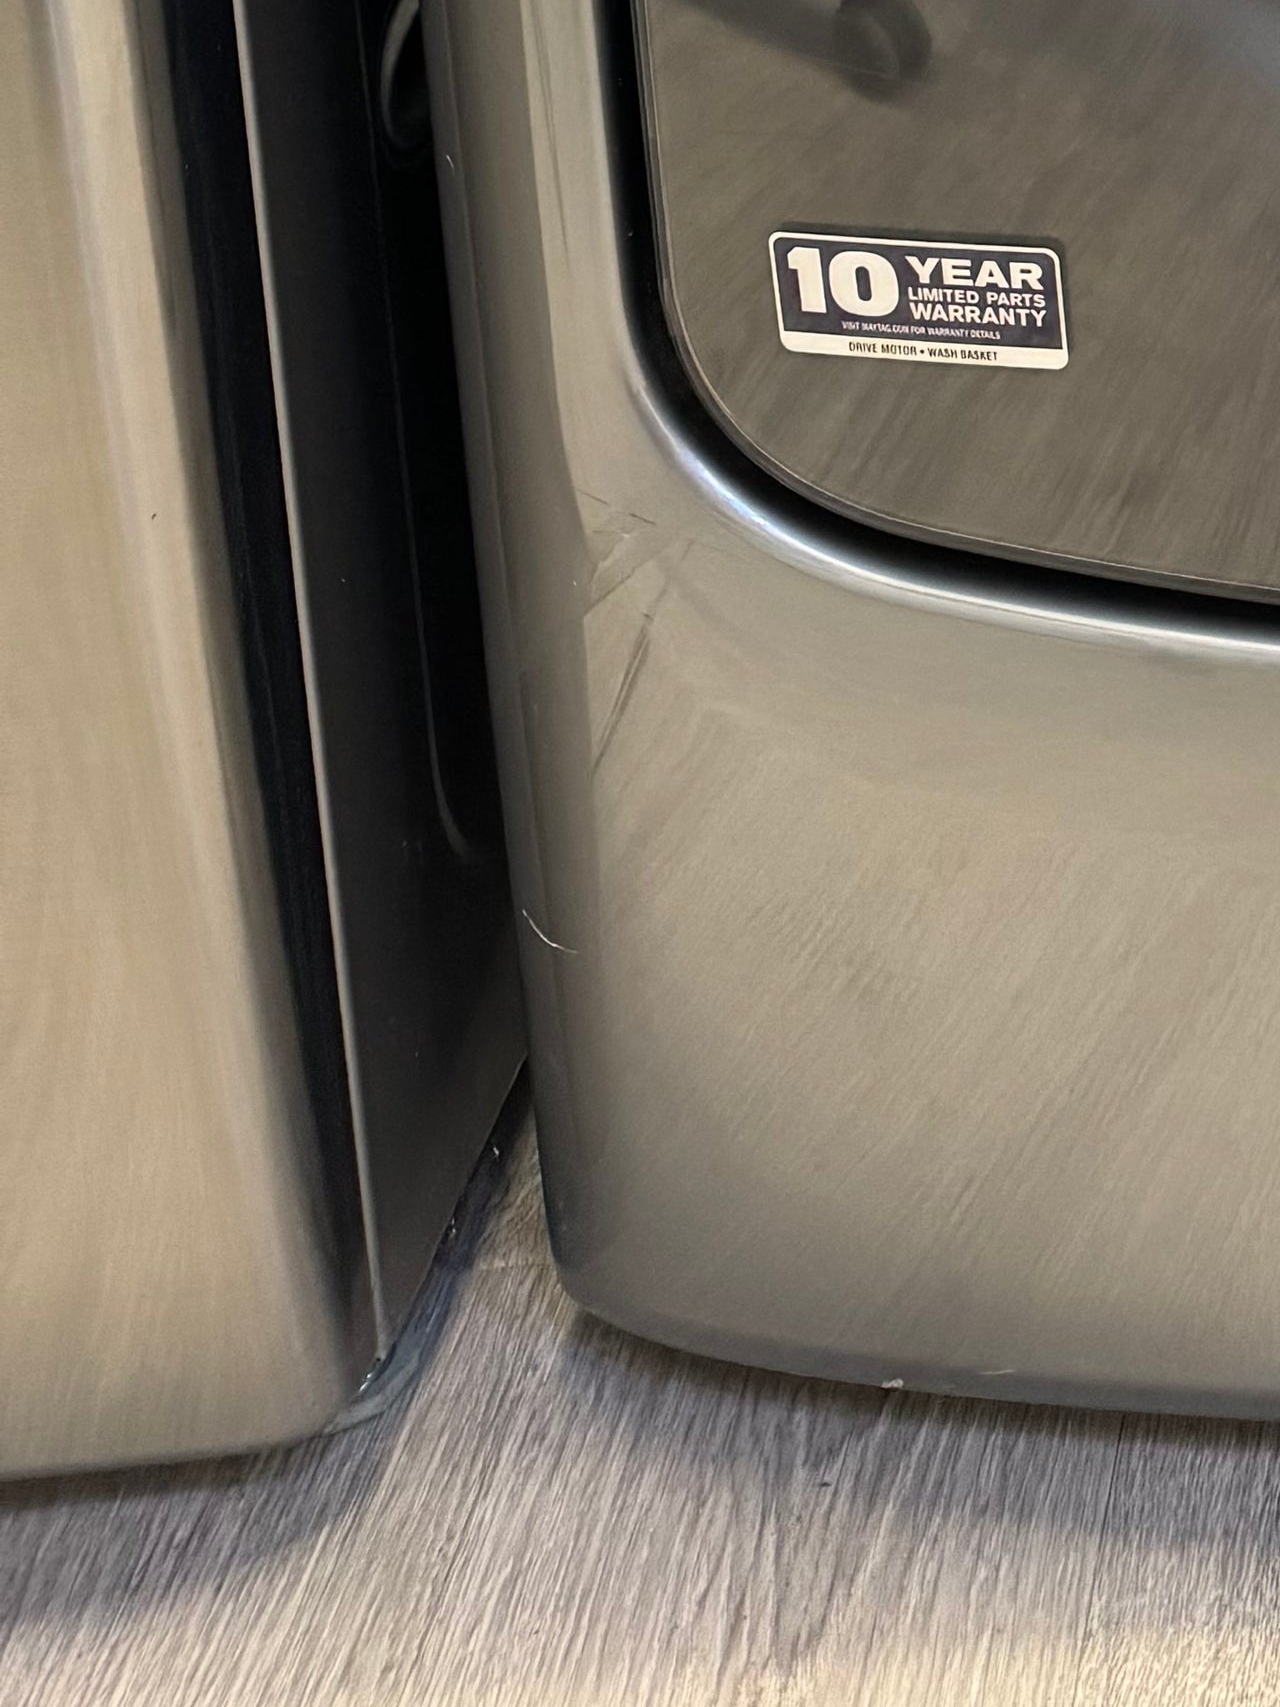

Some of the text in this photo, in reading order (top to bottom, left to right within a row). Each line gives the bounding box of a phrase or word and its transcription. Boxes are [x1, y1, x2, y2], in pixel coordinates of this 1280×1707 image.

[786, 245, 1045, 318] 10 YEAR
[907, 286, 1046, 309] LIMITED PARTS
[908, 301, 1047, 328] WARRANTY
[848, 341, 999, 362] DRIVE MOTOR WASH BASKET
